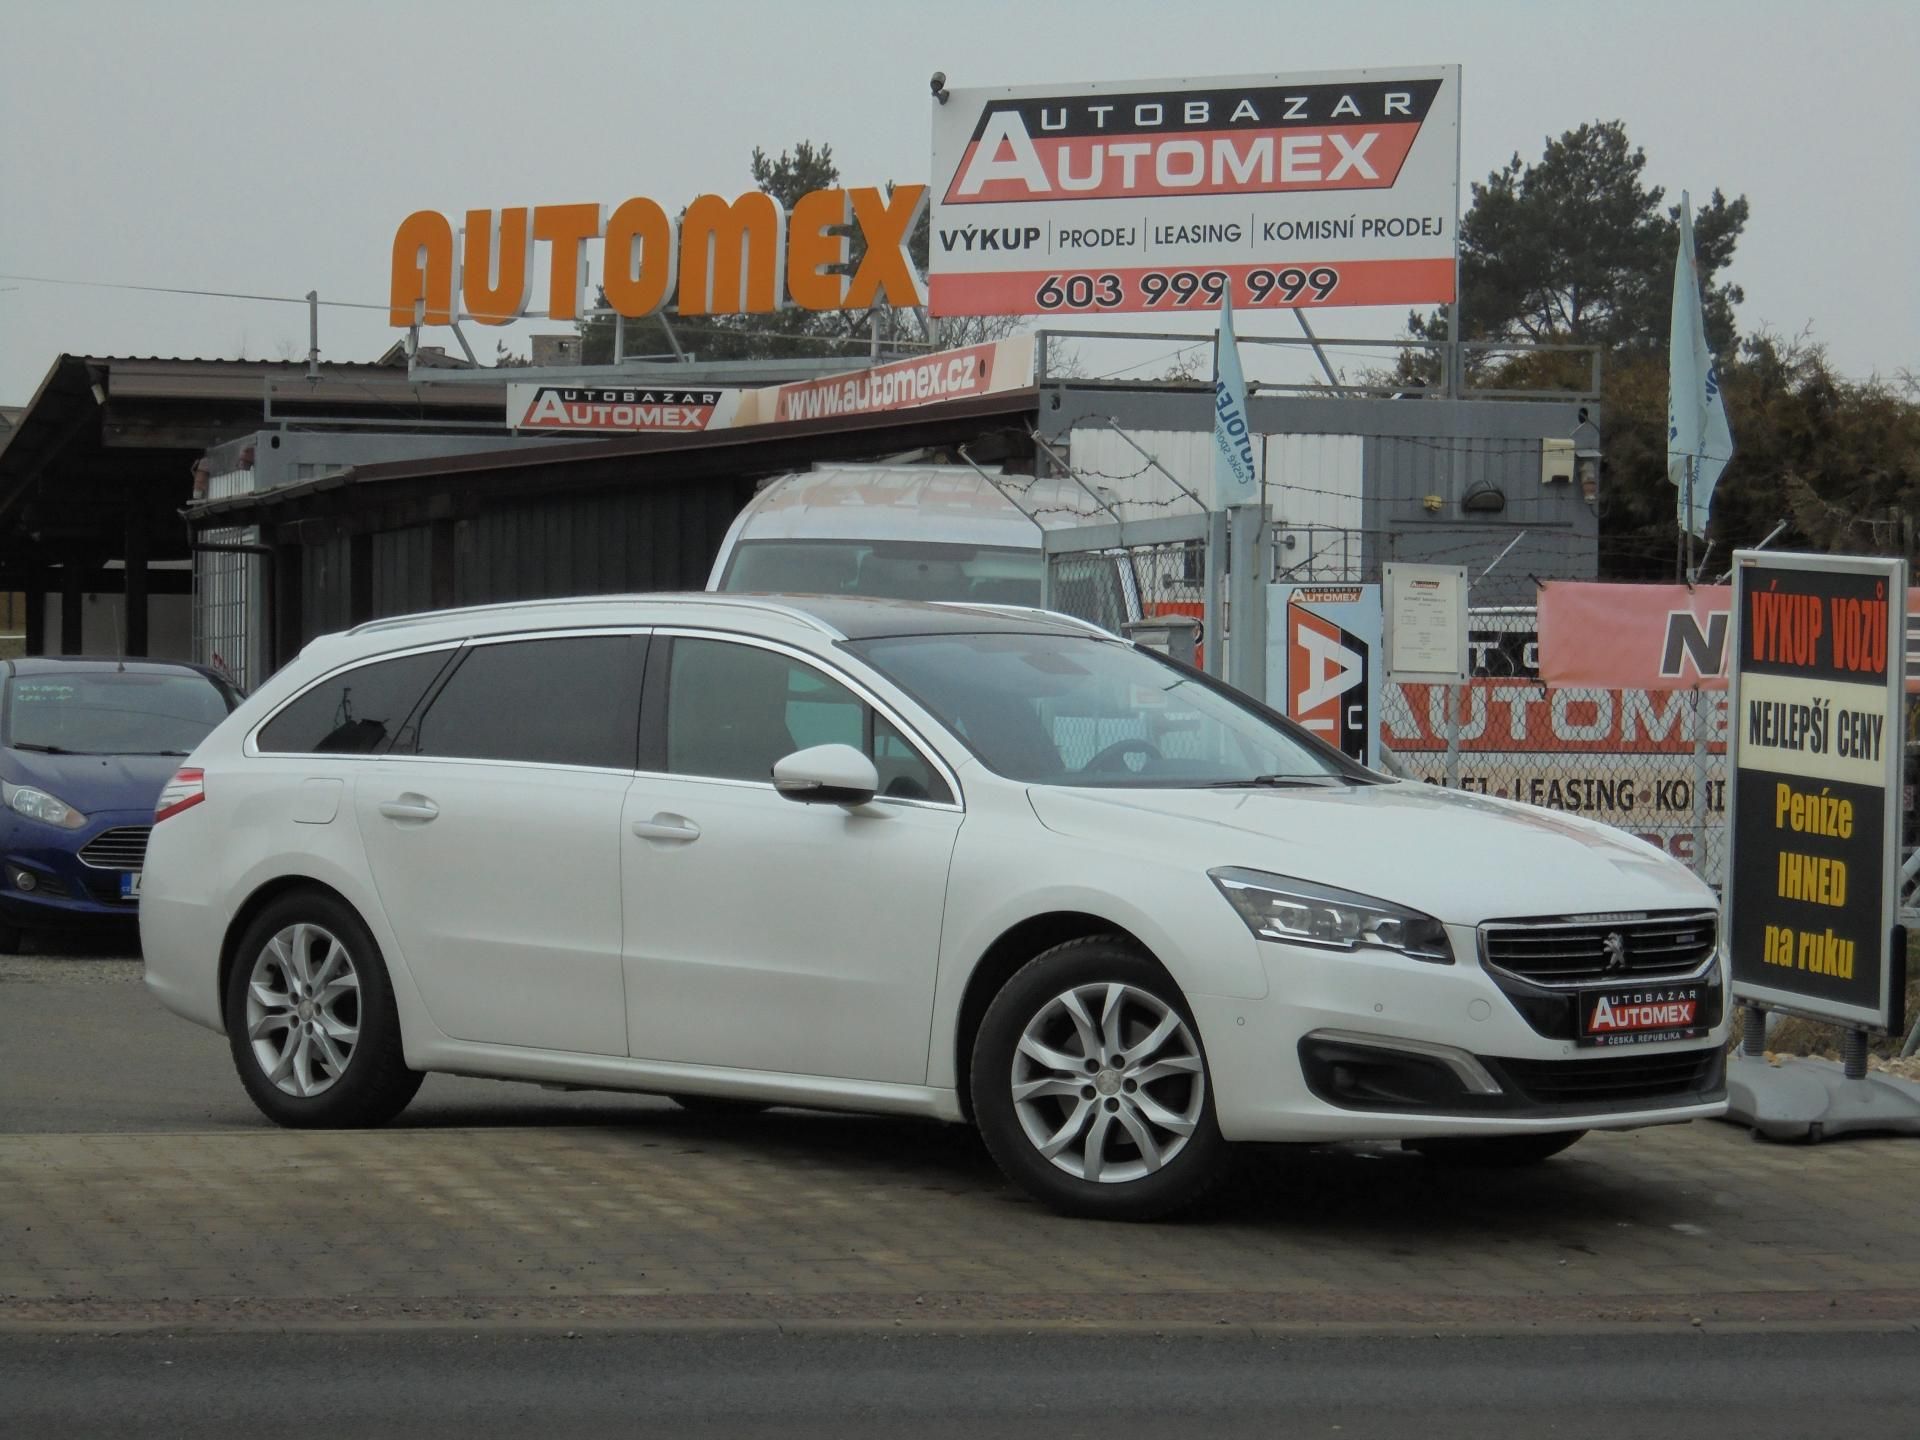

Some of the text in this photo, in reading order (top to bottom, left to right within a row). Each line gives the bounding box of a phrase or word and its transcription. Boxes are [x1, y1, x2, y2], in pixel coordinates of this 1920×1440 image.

[957, 110, 1382, 195] AUTOMEX
[390, 184, 929, 328] AUTOMEX
[939, 214, 1443, 252] VÝKUP PRODEJ LEASING KOMISNÍ PRODEJ
[1035, 267, 1339, 310] 603 999 999
[529, 389, 703, 426] AUTOMEX
[787, 363, 976, 421] www.automex.cz
[1289, 588, 1358, 601] AUTOMEX
[1659, 610, 1731, 679] N
[1751, 579, 1823, 667] VÝKUP
[1831, 585, 1888, 675] VOZŮ
[1748, 698, 1884, 762] NEJLEPŠÍ CENY
[1775, 782, 1854, 840] Peníze
[1778, 851, 1847, 908] IHNED
[1763, 925, 1854, 980] na ruku
[1592, 997, 1691, 1029] AUTOMEX
[1608, 1031, 1681, 1045] ČESKÁ REPUBLIKA
